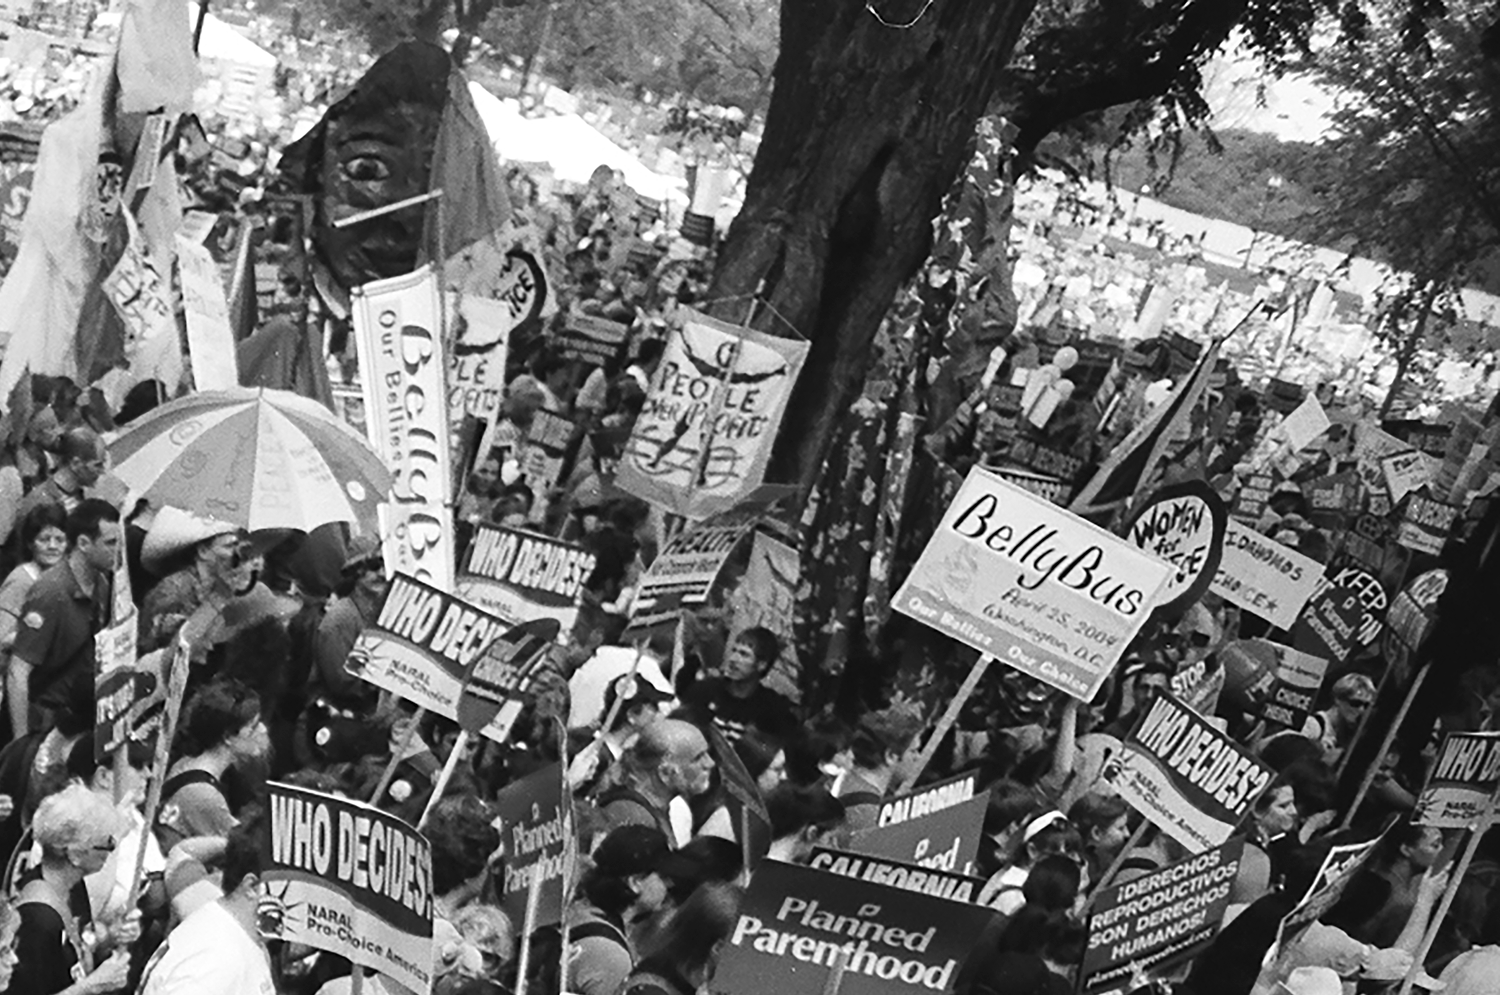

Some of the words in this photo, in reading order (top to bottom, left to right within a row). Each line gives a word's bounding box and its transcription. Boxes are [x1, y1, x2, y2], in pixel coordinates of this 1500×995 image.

[378, 309, 397, 360] Our
[1133, 499, 1206, 550] WOMEN
[467, 526, 519, 581] WHO
[509, 537, 597, 598] DECIDES?
[952, 493, 1144, 617] BellyBus
[376, 576, 443, 645] WHO
[908, 597, 939, 618] Our
[1332, 566, 1387, 611] KEEP
[1007, 645, 1037, 666] Our
[1170, 660, 1207, 698] STOP
[1134, 695, 1190, 759] WHO
[1169, 722, 1272, 817] DECIDES?
[1435, 737, 1488, 783] WHO
[270, 793, 332, 877] WHO
[337, 808, 434, 922] DECIDES?
[511, 804, 564, 858] Planned
[1089, 860, 1239, 930] REPRODUCTIVOS
[1117, 848, 1222, 903] ¡DERECHOS
[307, 902, 353, 930] NARAL
[775, 896, 938, 954] Planned
[1087, 921, 1130, 949] SON
[1134, 882, 1231, 938] DERECHOS
[1110, 911, 1207, 961] HUMANOS!
[307, 918, 384, 956] Pro-Choice
[386, 948, 432, 986] America
[730, 913, 957, 991] Parenthood
